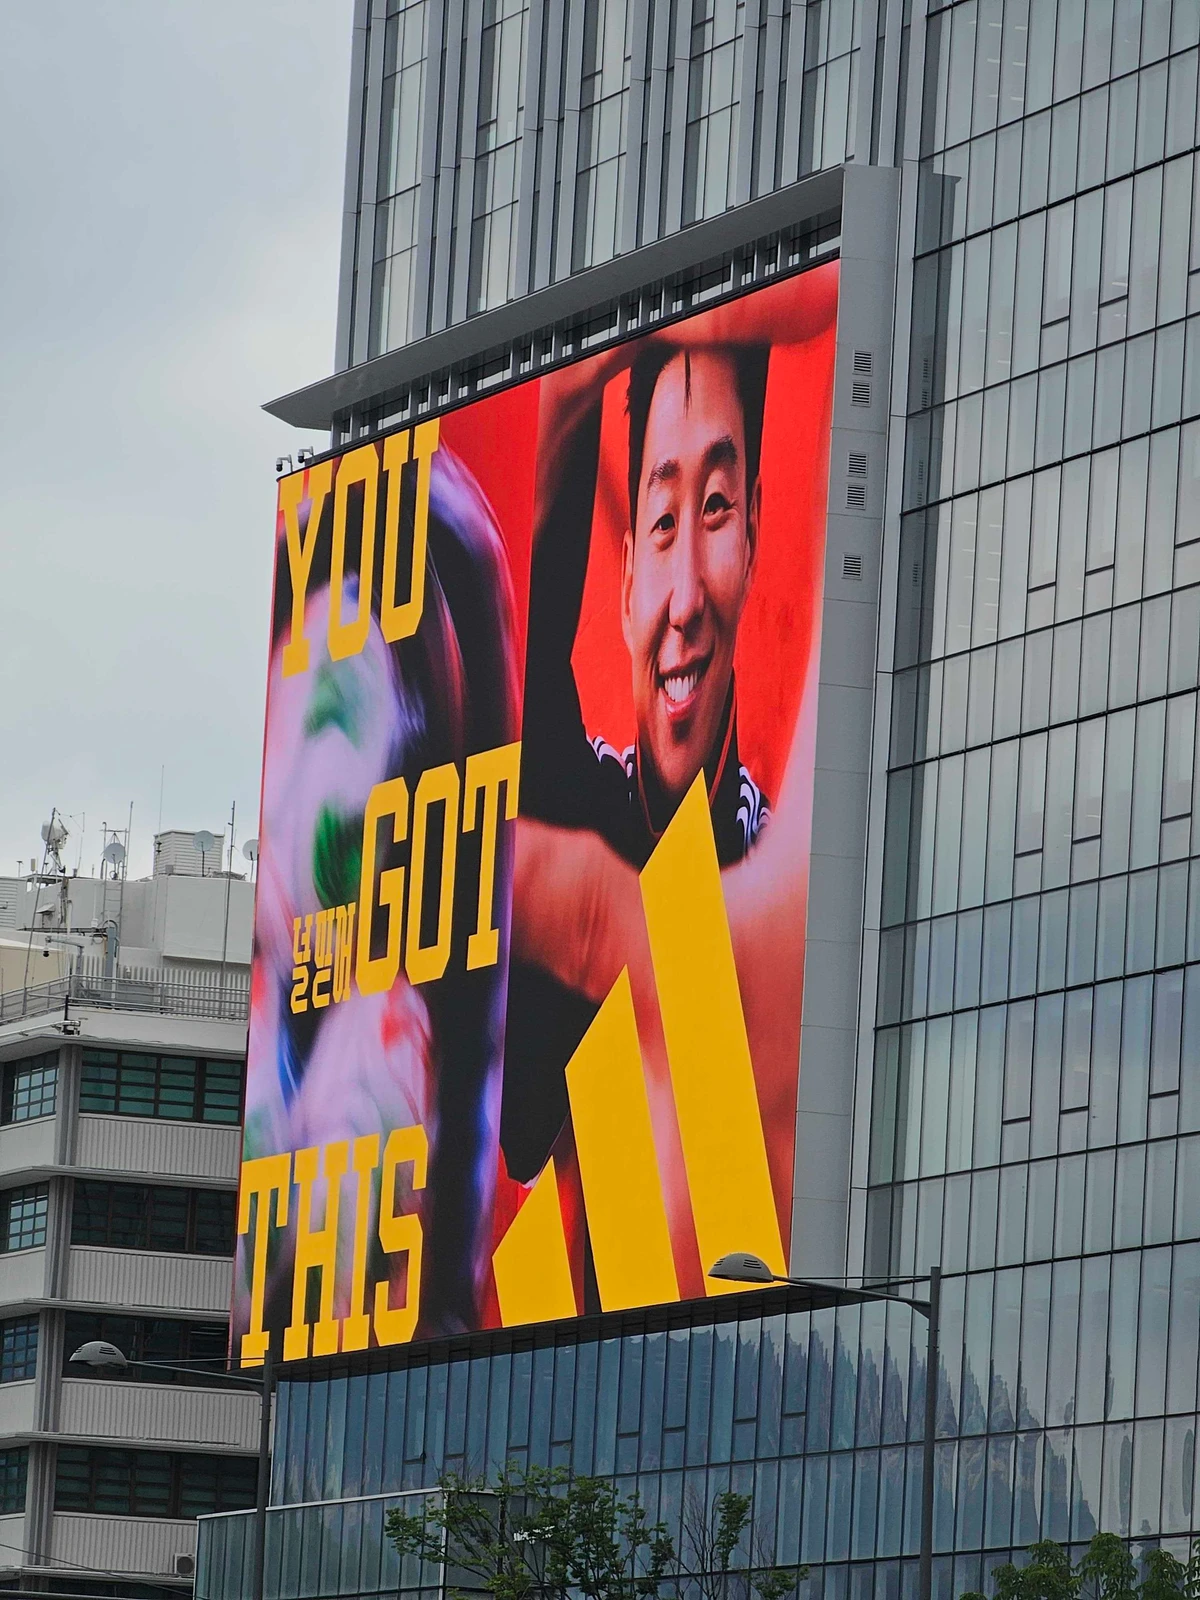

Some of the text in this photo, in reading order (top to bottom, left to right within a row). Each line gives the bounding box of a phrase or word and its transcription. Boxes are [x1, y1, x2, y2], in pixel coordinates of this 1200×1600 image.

[279, 417, 440, 679] YOU
[355, 741, 522, 997] GOT
[237, 1123, 429, 1369] THIS
